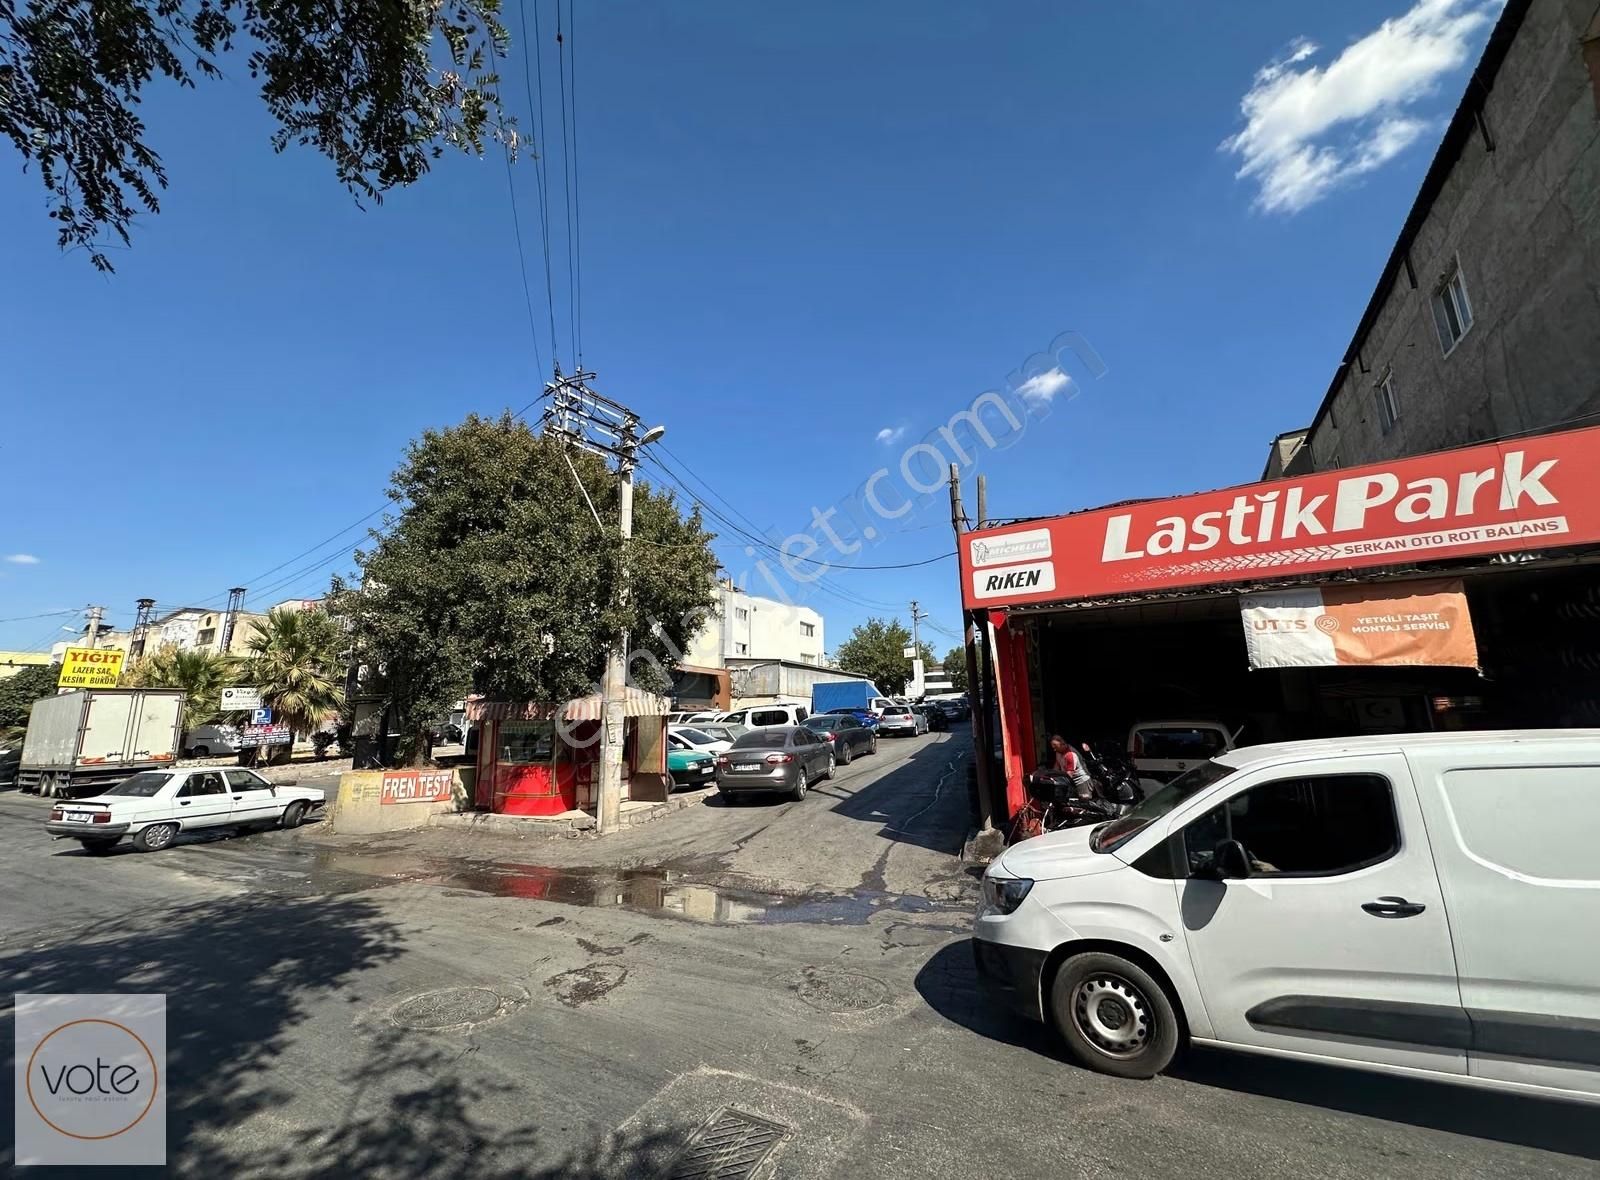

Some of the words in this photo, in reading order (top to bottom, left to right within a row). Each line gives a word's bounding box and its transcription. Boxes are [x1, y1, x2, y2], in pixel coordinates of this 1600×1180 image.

[1344, 538, 1407, 555] SERKAN
[1411, 534, 1444, 547] OTO
[1448, 529, 1481, 543] ROT
[1486, 520, 1560, 538] BALANS
[988, 540, 1048, 557] MICHELIN
[1254, 618, 1308, 632] UTTS
[1352, 623, 1401, 634] MONTAJ
[72, 666, 95, 674] LAZER
[382, 777, 417, 799] FREN
